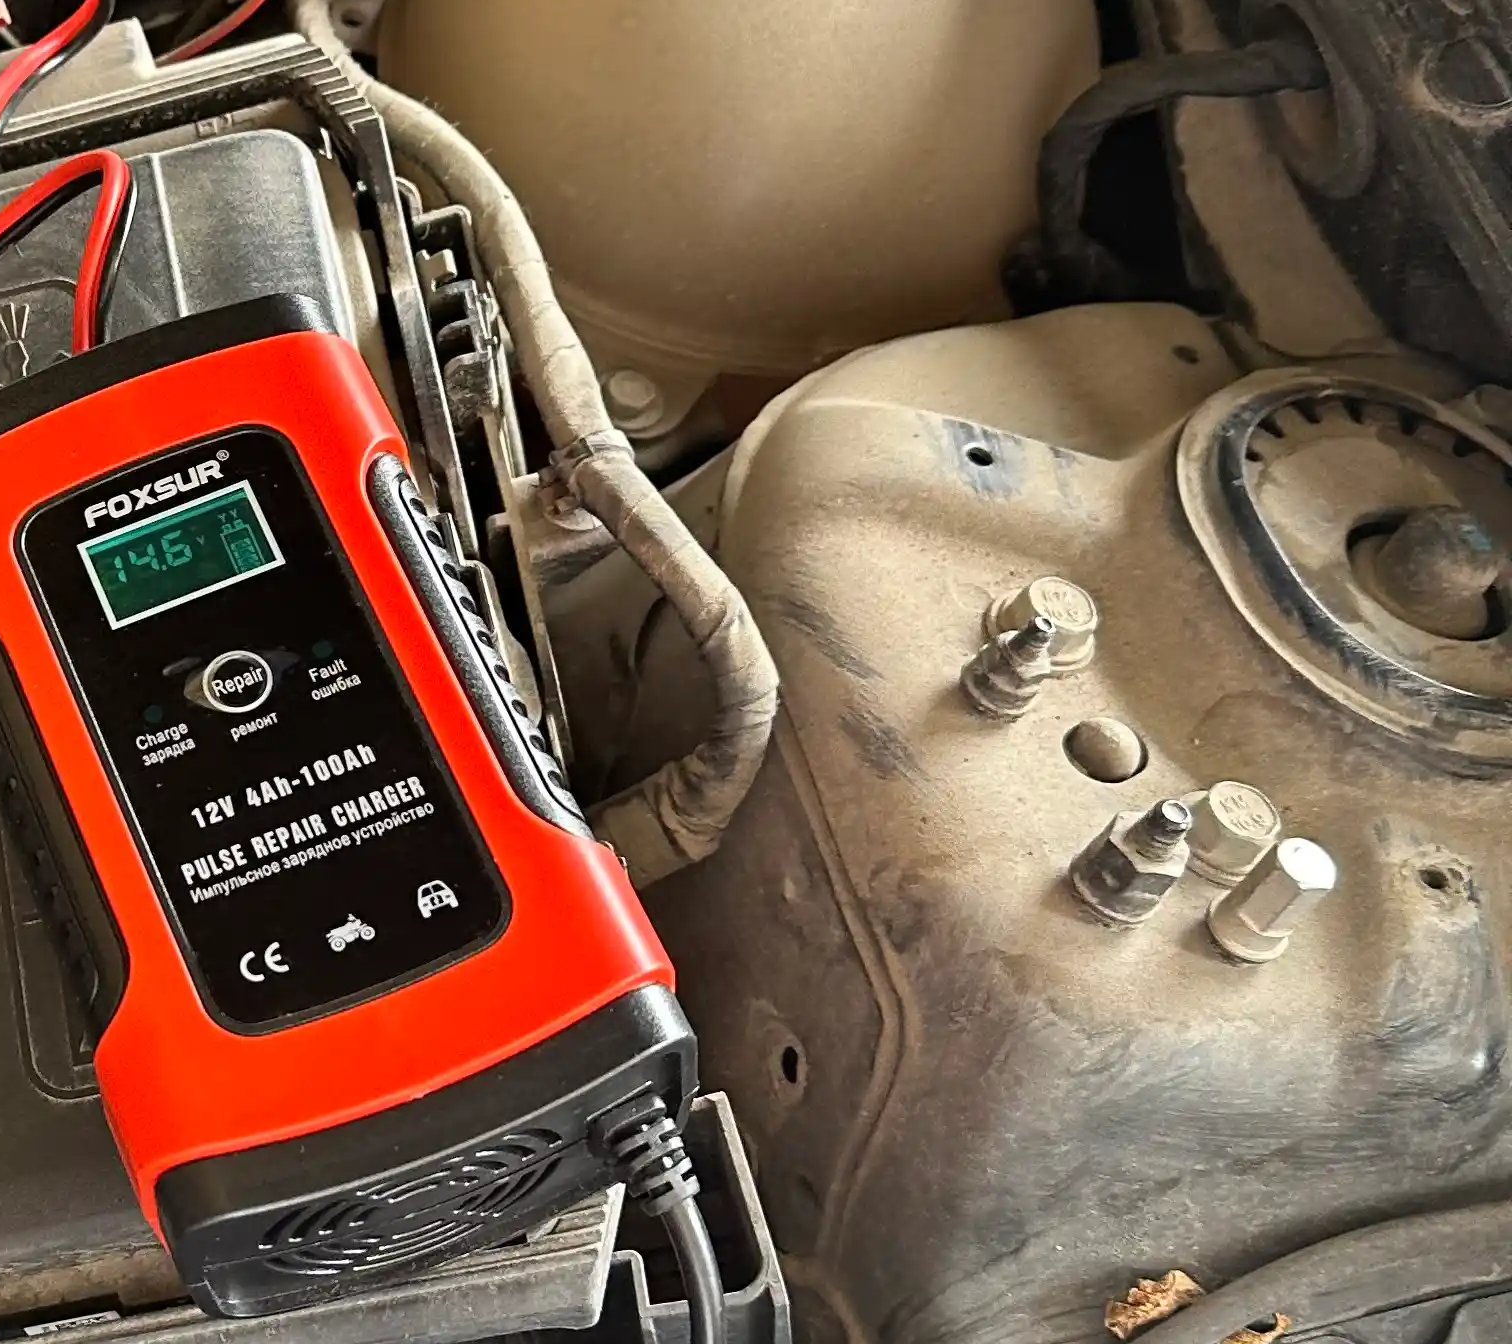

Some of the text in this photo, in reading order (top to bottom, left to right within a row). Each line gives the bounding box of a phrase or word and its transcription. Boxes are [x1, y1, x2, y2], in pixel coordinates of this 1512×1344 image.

[113, 529, 193, 583] 14.6
[211, 665, 264, 697] Repair
[308, 657, 348, 683] Fault
[311, 673, 362, 701] ошибка
[135, 722, 189, 751] Charge
[230, 712, 279, 742] ремонт
[142, 737, 196, 766] зарядка
[191, 744, 376, 828] 12V 4Ah-100Ah
[180, 775, 426, 885] PULSE REPAIR CHARGER
[189, 802, 435, 903] Импульсное зарядное устройство
[239, 941, 290, 982] CE
